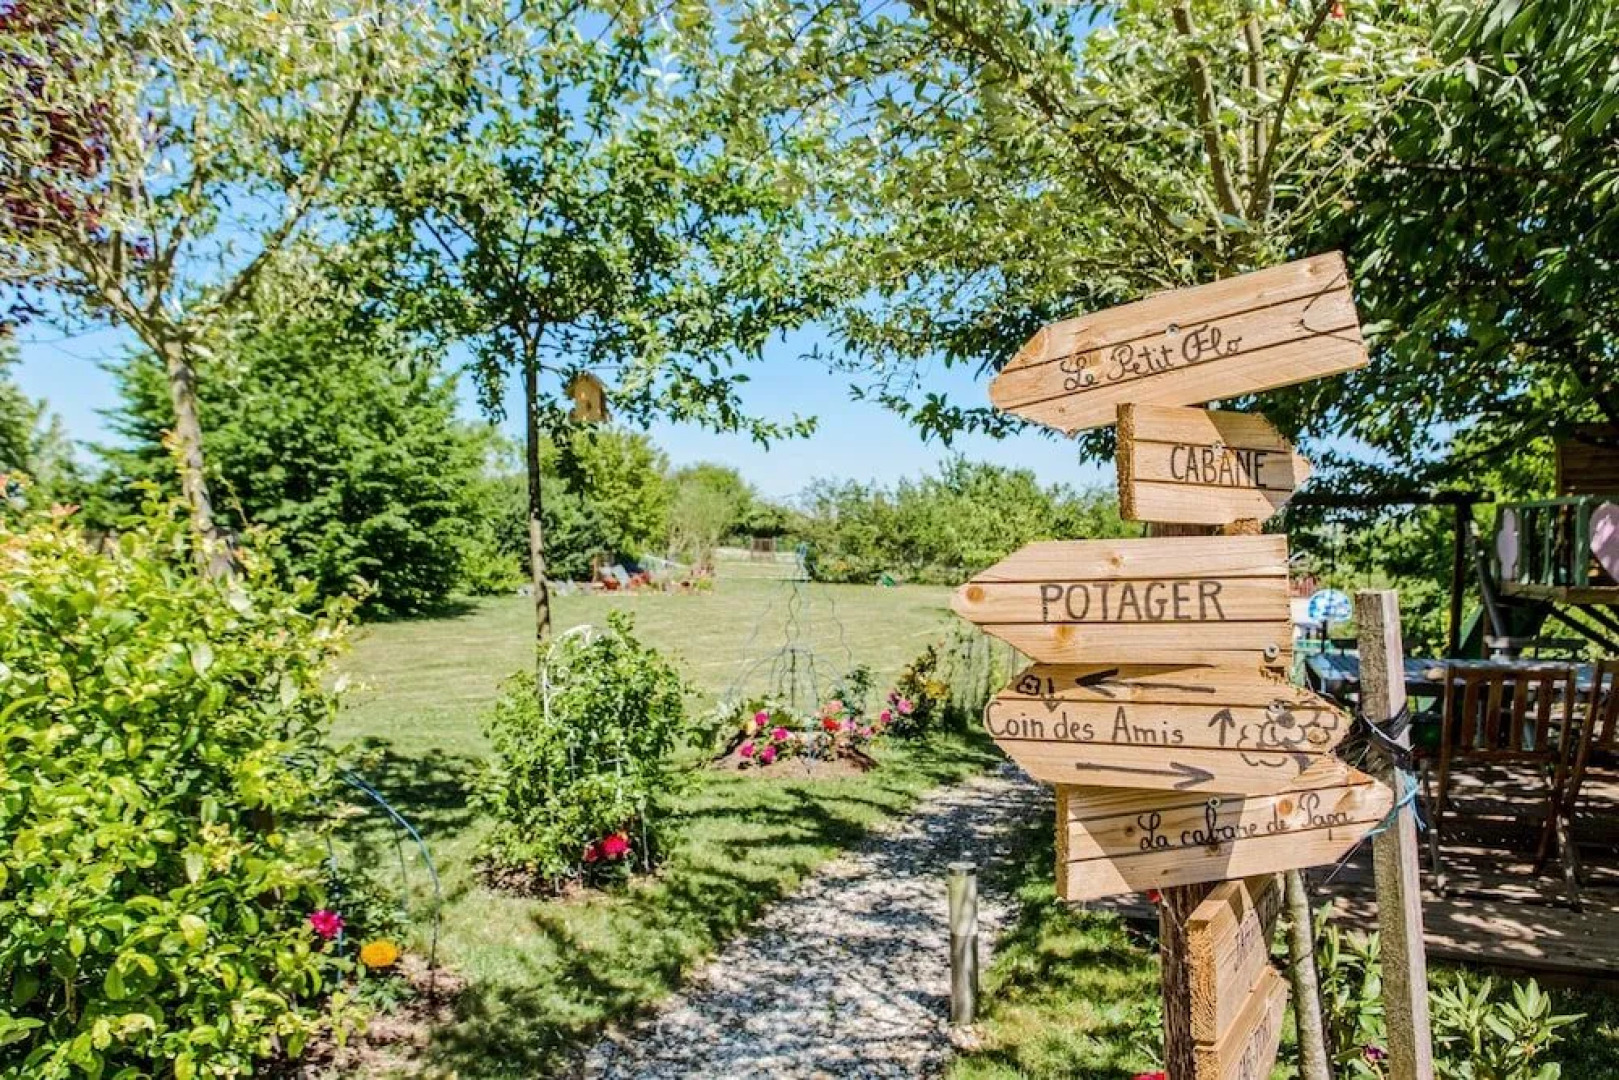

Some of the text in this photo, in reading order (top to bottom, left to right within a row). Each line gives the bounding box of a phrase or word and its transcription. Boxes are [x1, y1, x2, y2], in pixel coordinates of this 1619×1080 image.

[1060, 355, 1100, 391] Le
[1107, 343, 1175, 381] Petit
[1170, 446, 1268, 488] CABANE
[1040, 580, 1226, 622] POTAGER
[986, 701, 1184, 744] Coin des Amis
[1137, 792, 1350, 850] La cabane de Papa
